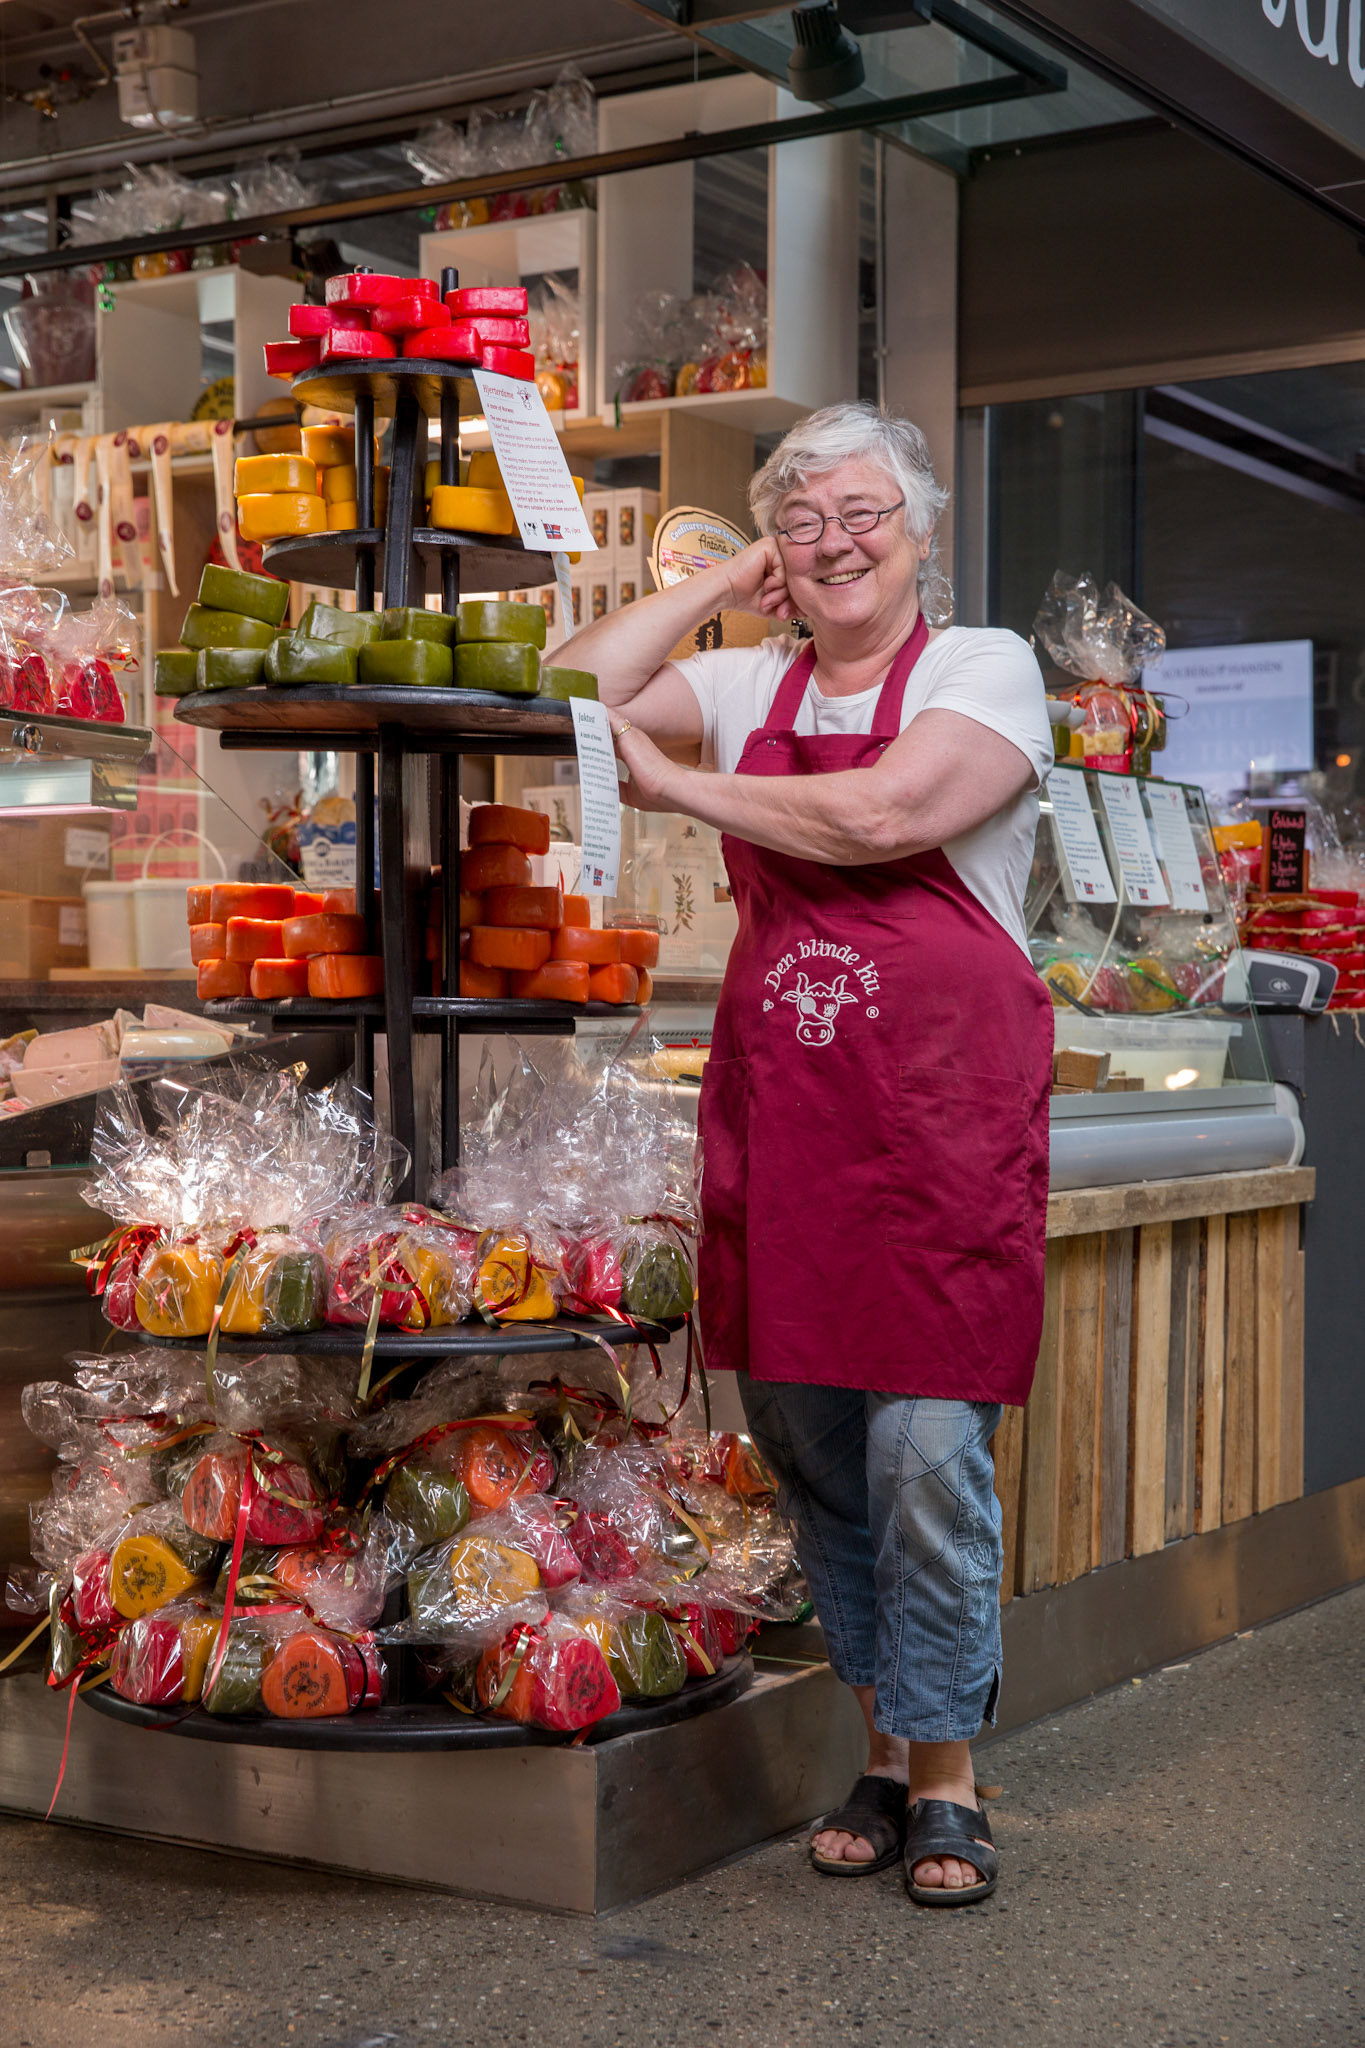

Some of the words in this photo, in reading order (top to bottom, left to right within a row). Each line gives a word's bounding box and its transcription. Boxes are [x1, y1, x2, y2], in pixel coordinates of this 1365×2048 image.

[483, 384, 514, 399] Hjerterdame
[670, 522, 704, 542] Confitures
[704, 523, 722, 534] pour
[698, 533, 728, 553] Antona
[765, 953, 797, 993] Den
[797, 939, 860, 965] blinde
